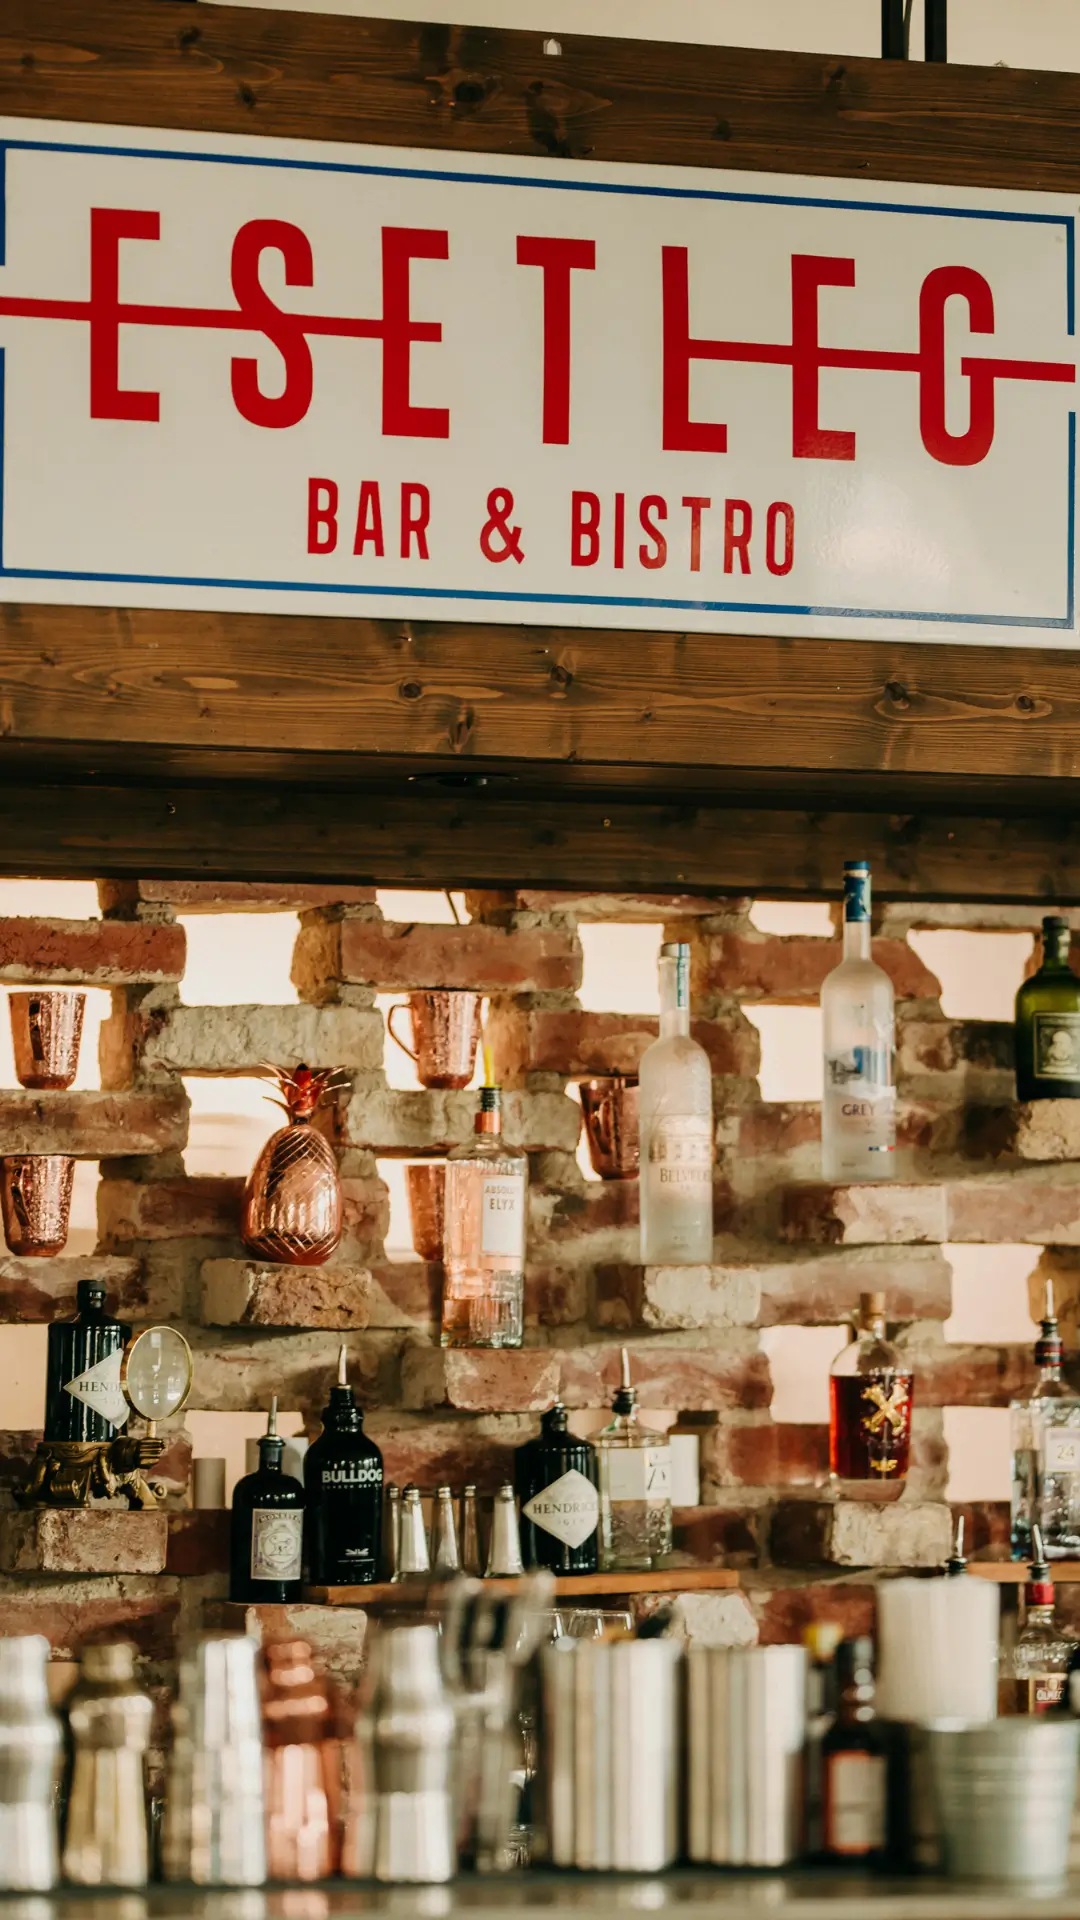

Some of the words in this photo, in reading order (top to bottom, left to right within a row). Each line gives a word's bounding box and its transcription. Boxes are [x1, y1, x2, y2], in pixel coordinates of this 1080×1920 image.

[90, 208, 994, 466] ESETLEG
[307, 477, 431, 561] BAR
[480, 488, 525, 565] &
[571, 491, 795, 577] BISTRO
[490, 1198, 515, 1210] ELYX
[322, 1468, 383, 1484] BULLDOG
